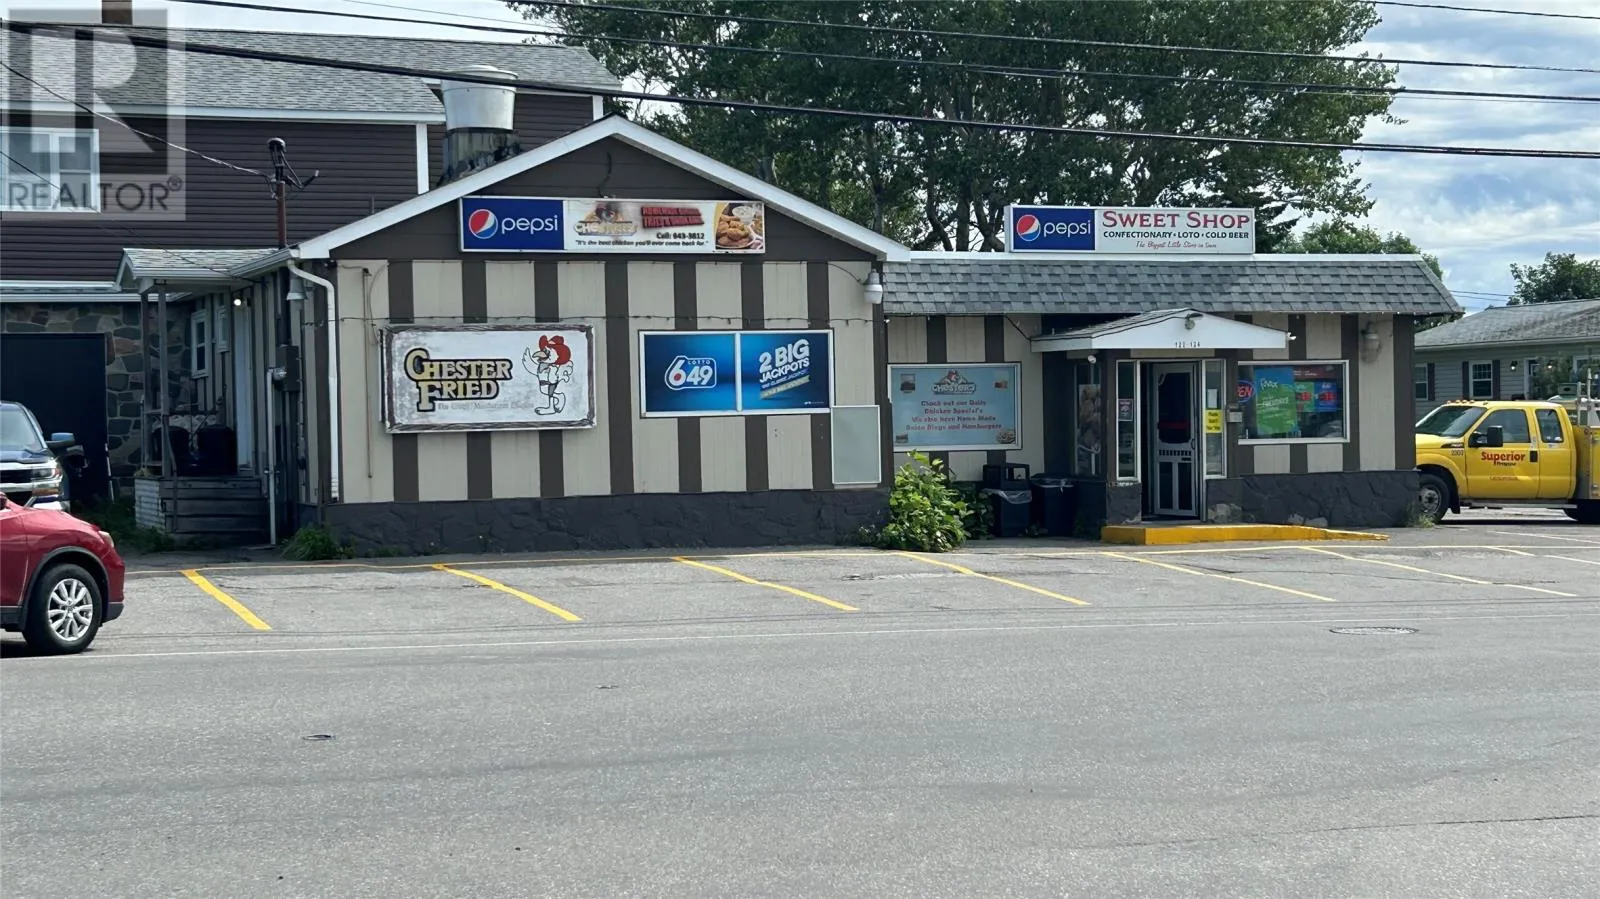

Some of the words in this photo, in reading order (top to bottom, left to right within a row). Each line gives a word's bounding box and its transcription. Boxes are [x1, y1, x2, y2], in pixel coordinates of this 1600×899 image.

[501, 214, 558, 235] pepsi
[1043, 219, 1091, 238] pepsi
[1102, 210, 1181, 228] SWEET
[1186, 211, 1250, 229] SHOP
[1103, 231, 1172, 239] CONFECTIONARY
[1178, 231, 1200, 239] LOTO
[1205, 231, 1227, 239] COLD
[1228, 231, 1249, 239] BEER
[404, 348, 512, 381] CHESTER
[759, 351, 773, 374] 2
[775, 339, 810, 367] BIG
[759, 357, 810, 383] JACKPOTS
[416, 379, 500, 412] FRIED
[1481, 451, 1526, 464] Superior
